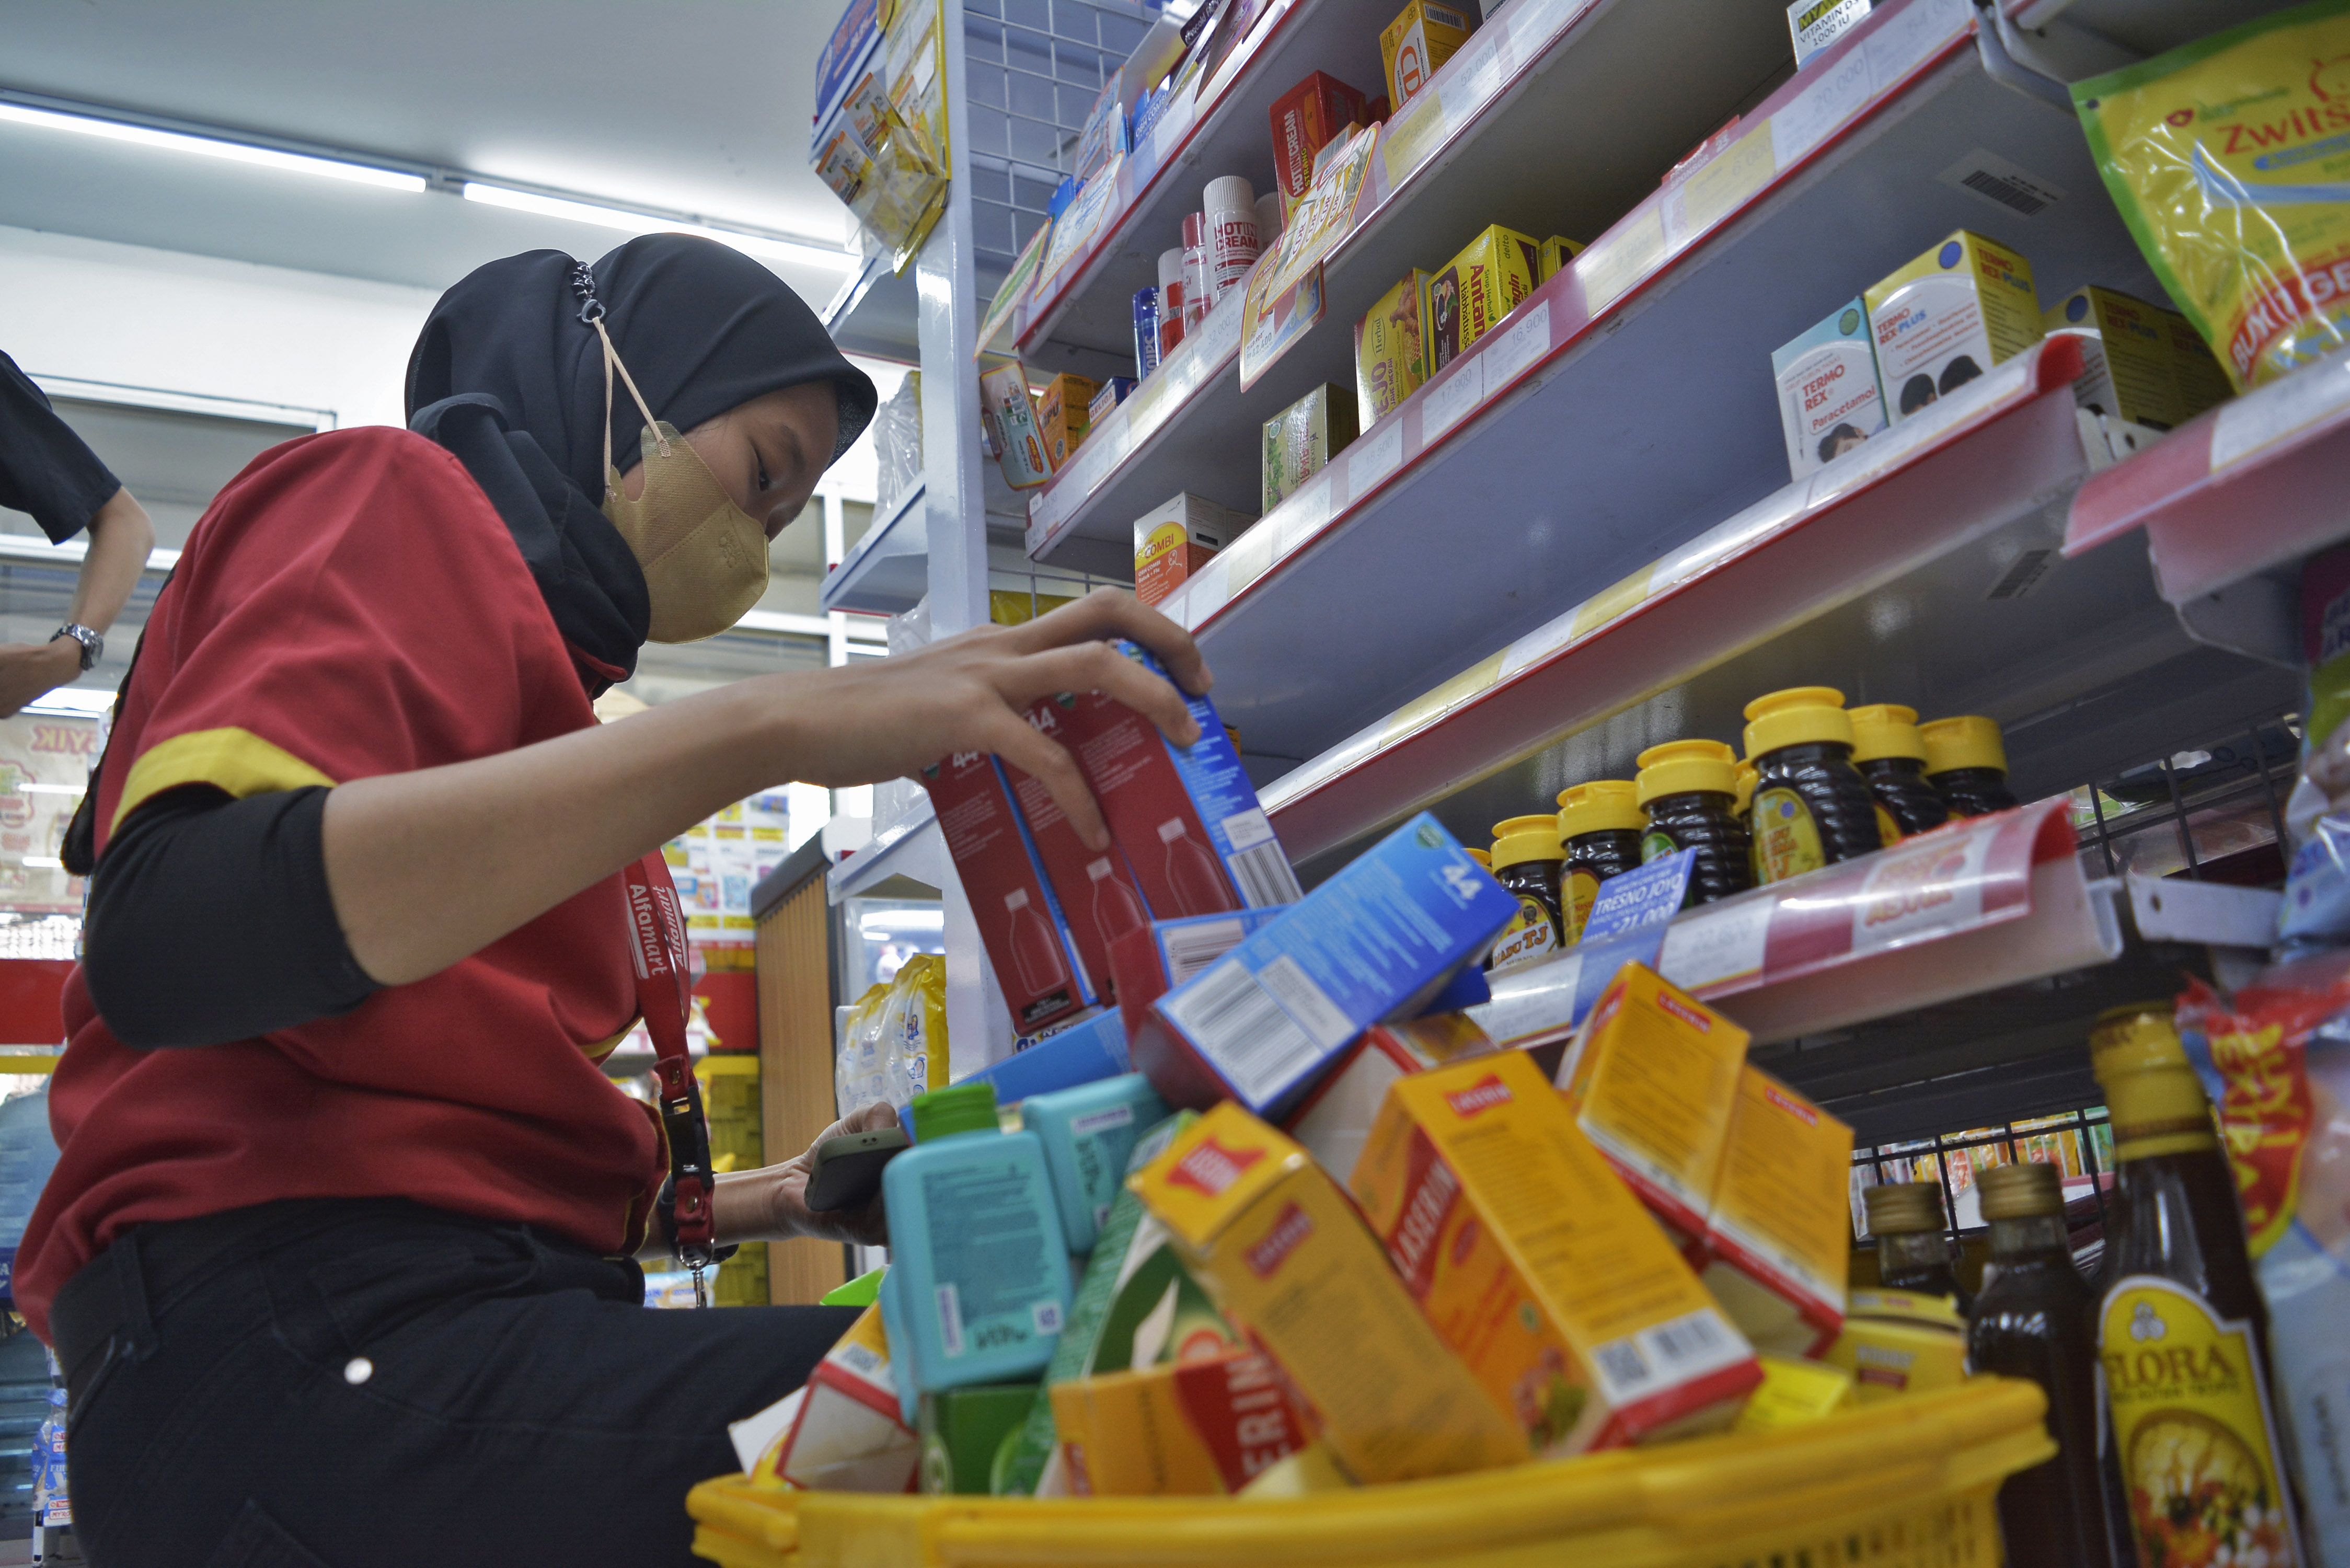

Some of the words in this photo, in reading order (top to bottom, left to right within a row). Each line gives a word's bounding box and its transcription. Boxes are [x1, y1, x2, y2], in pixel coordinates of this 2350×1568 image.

[1800, 7, 1842, 43] VITAMIN
[1813, 24, 1836, 46] 1000
[1838, 14, 1850, 27] IU
[1215, 236, 1259, 252] CREAM
[1469, 264, 1486, 340] Antan
[1374, 318, 1383, 354] Herbal
[1877, 307, 1911, 334] TERMO
[1897, 309, 1927, 333] PLUS
[1802, 364, 1845, 397] TERMO
[1089, 392, 1113, 419] GELIGA
[1804, 389, 1828, 412] REX
[1812, 385, 1876, 431] Paracetamol
[1145, 534, 1174, 559] COMBI
[1138, 566, 1147, 578] OBH
[1147, 559, 1161, 573] COMBI
[1138, 572, 1150, 583] Batuk
[1442, 863, 1484, 899] 44
[1595, 886, 1647, 915] TRESNO
[1647, 872, 1684, 899] JOYO
[629, 884, 667, 976] Alfamart
[652, 885, 684, 965] Alfamart
[1522, 925, 1549, 950] TJ
